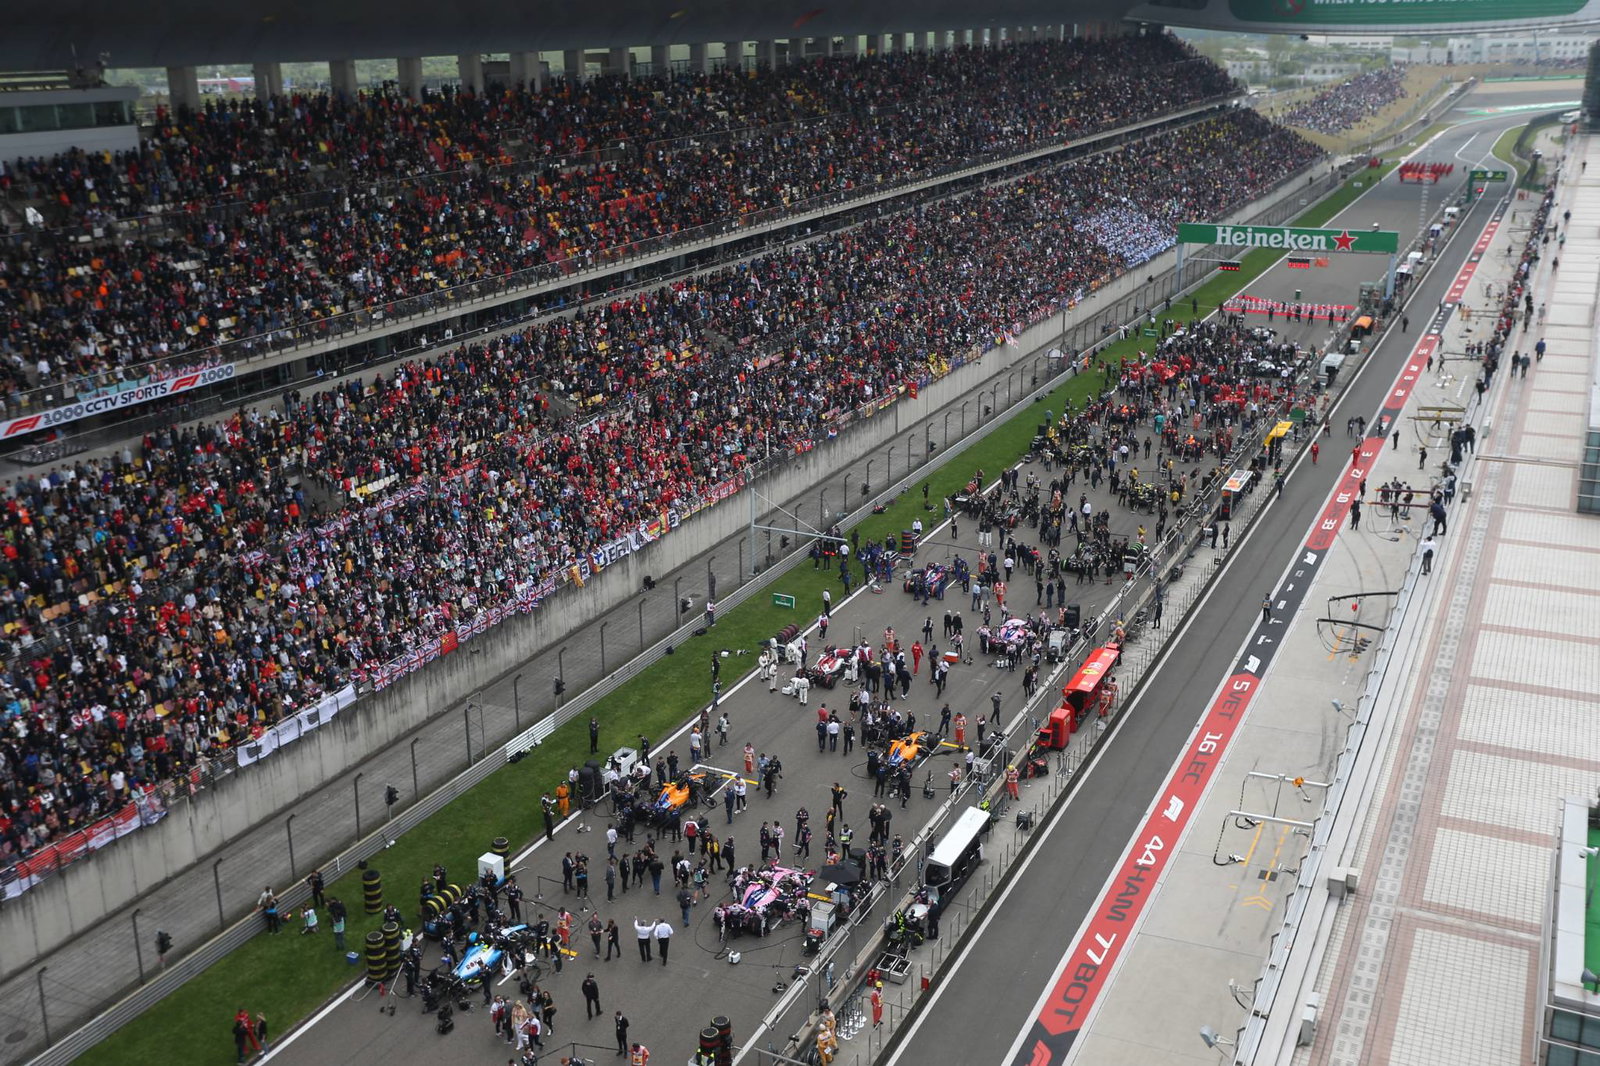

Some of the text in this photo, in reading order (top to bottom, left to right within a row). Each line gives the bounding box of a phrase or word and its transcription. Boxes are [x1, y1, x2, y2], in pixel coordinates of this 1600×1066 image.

[1215, 226, 1327, 250] Heineken
[43, 408, 85, 426] 1000
[85, 395, 118, 414] CCTV
[120, 383, 168, 405] SPORTS
[200, 364, 234, 384] 1000
[1350, 468, 1364, 479] 27
[1336, 492, 1351, 503] 10
[1321, 518, 1337, 530] 33
[1106, 835, 1164, 922] 44 HAM
[1054, 932, 1117, 1025] 77 BOT
